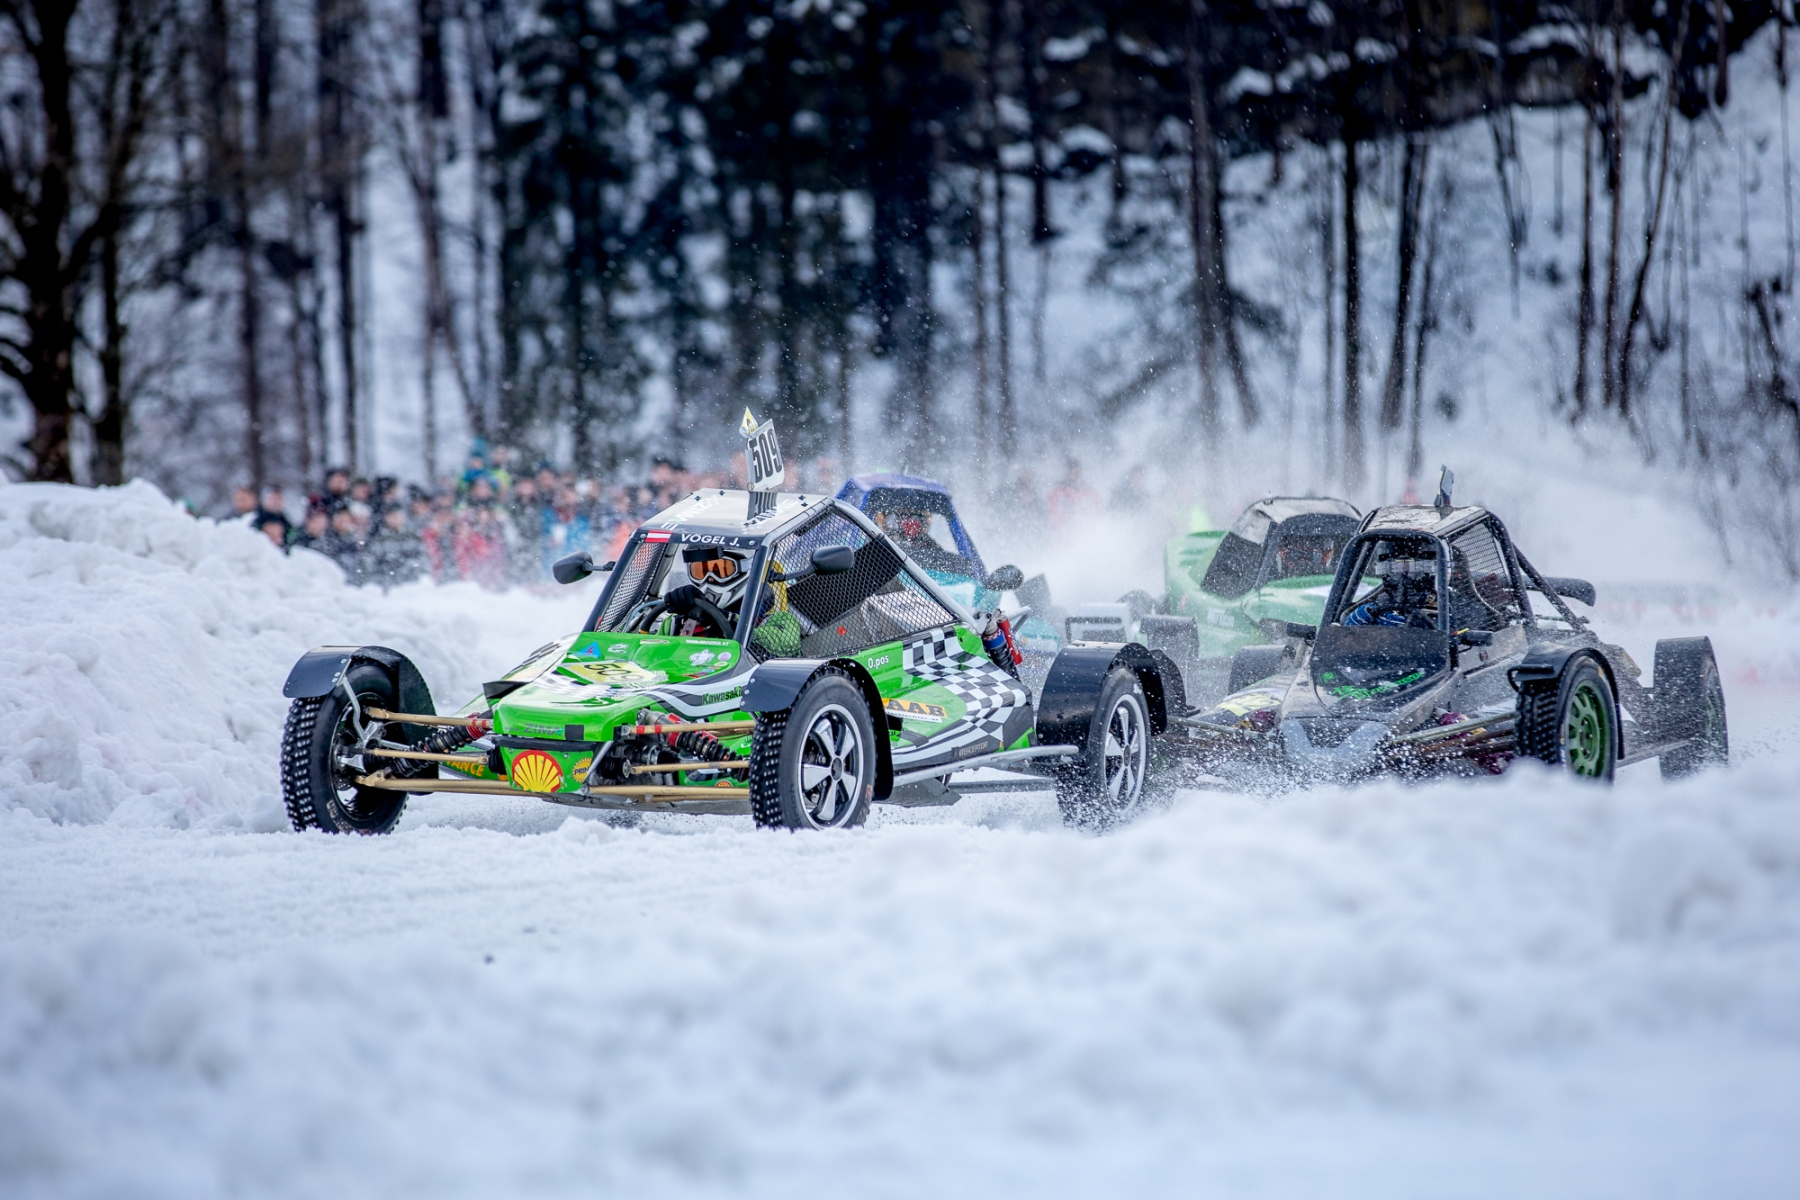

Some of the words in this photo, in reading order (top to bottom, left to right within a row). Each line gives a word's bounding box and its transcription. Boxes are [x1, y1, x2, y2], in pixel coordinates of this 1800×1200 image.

[749, 428, 783, 483] 509
[729, 537, 740, 547] J.
[703, 686, 742, 705] Kawasaki
[884, 699, 946, 717] AAB
